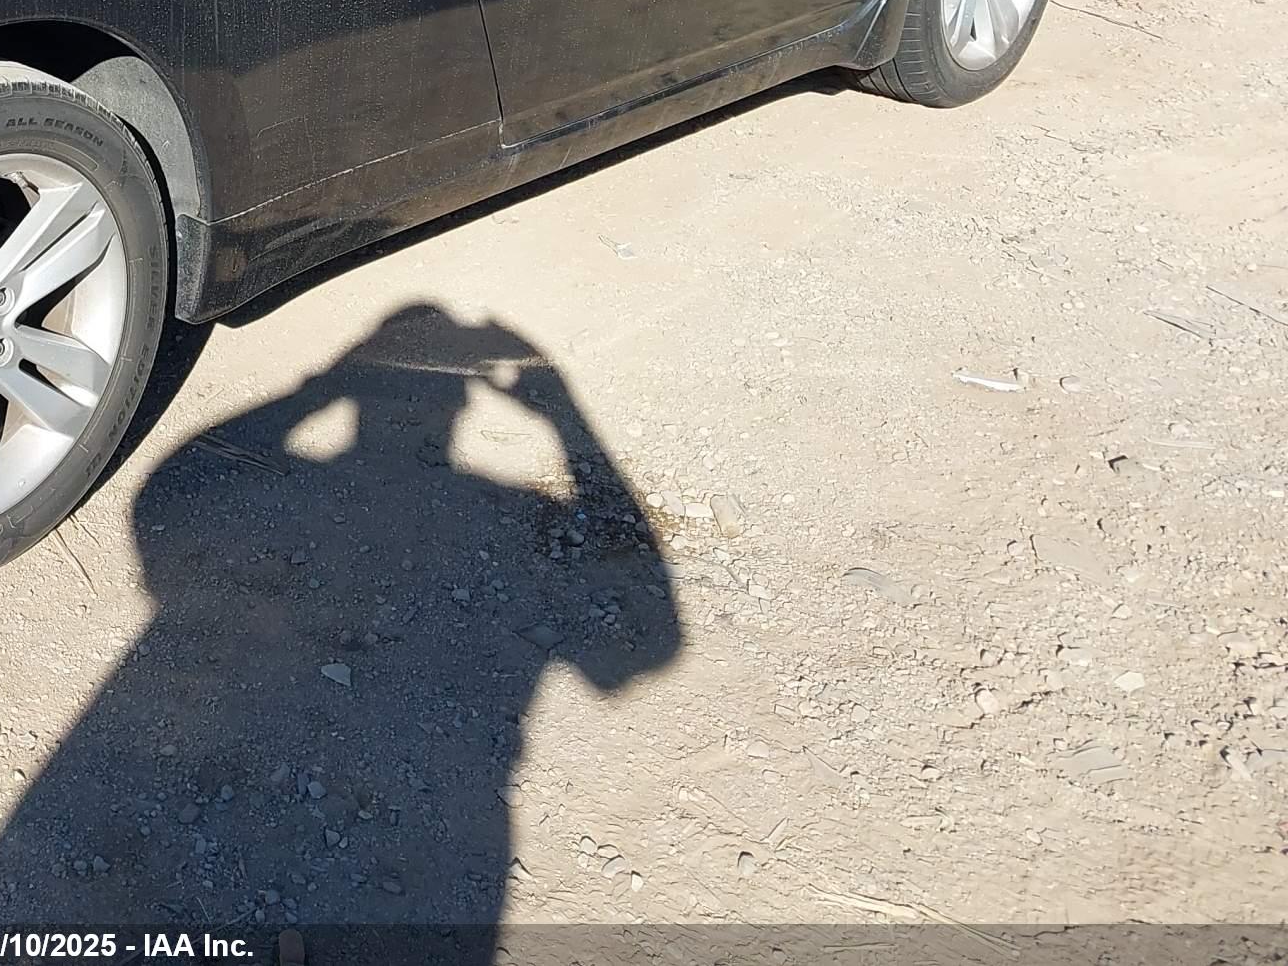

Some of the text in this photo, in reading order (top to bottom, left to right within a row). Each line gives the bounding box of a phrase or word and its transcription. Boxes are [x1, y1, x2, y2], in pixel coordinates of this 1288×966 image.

[5, 117, 105, 147] ALL SEASON
[147, 244, 161, 332] SILVER
[109, 343, 150, 442] EDITION
